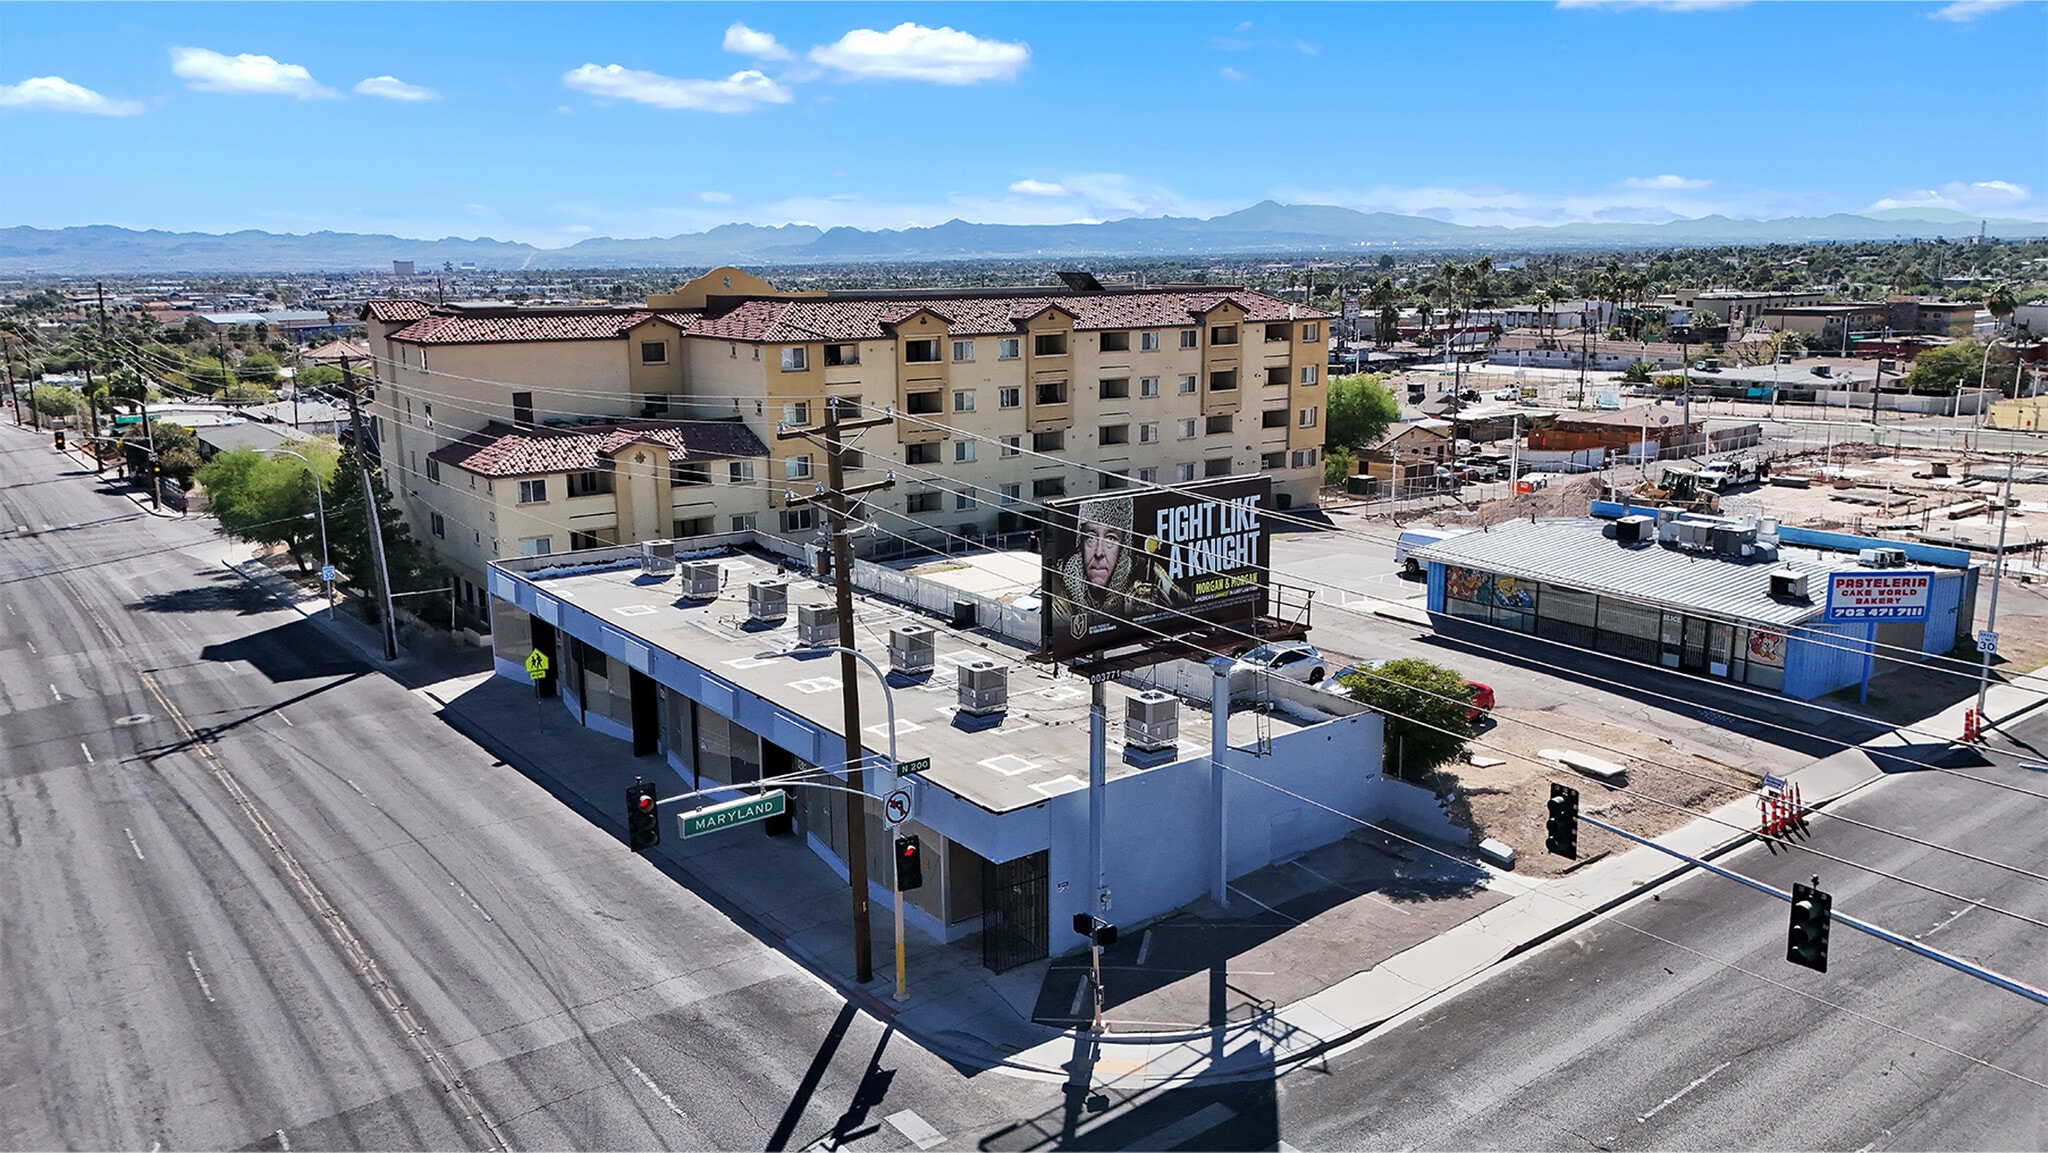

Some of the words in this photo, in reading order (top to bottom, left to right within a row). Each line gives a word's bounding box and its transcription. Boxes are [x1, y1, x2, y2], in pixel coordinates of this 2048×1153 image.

[1157, 503, 1216, 543] FIGHT
[1220, 494, 1261, 535] LIKE
[1169, 545, 1183, 580] A
[1188, 531, 1260, 577] KNIGHT
[1195, 579, 1224, 595] MORGAN
[1225, 577, 1230, 589] &
[1231, 572, 1258, 588] MORGAN
[1836, 578, 1928, 588] PASTELERIA
[1841, 589, 1872, 597] CAKE
[1878, 589, 1918, 597] WORLD
[1855, 597, 1902, 605] BAKERY
[1835, 608, 1865, 617] 702
[1868, 608, 1894, 616] 471
[1897, 607, 1923, 616] 7111
[1979, 641, 1995, 651] 30
[1091, 669, 1120, 684] 003771
[902, 765, 908, 773] N
[910, 760, 928, 771] 200
[695, 801, 773, 830] MARYLAND
